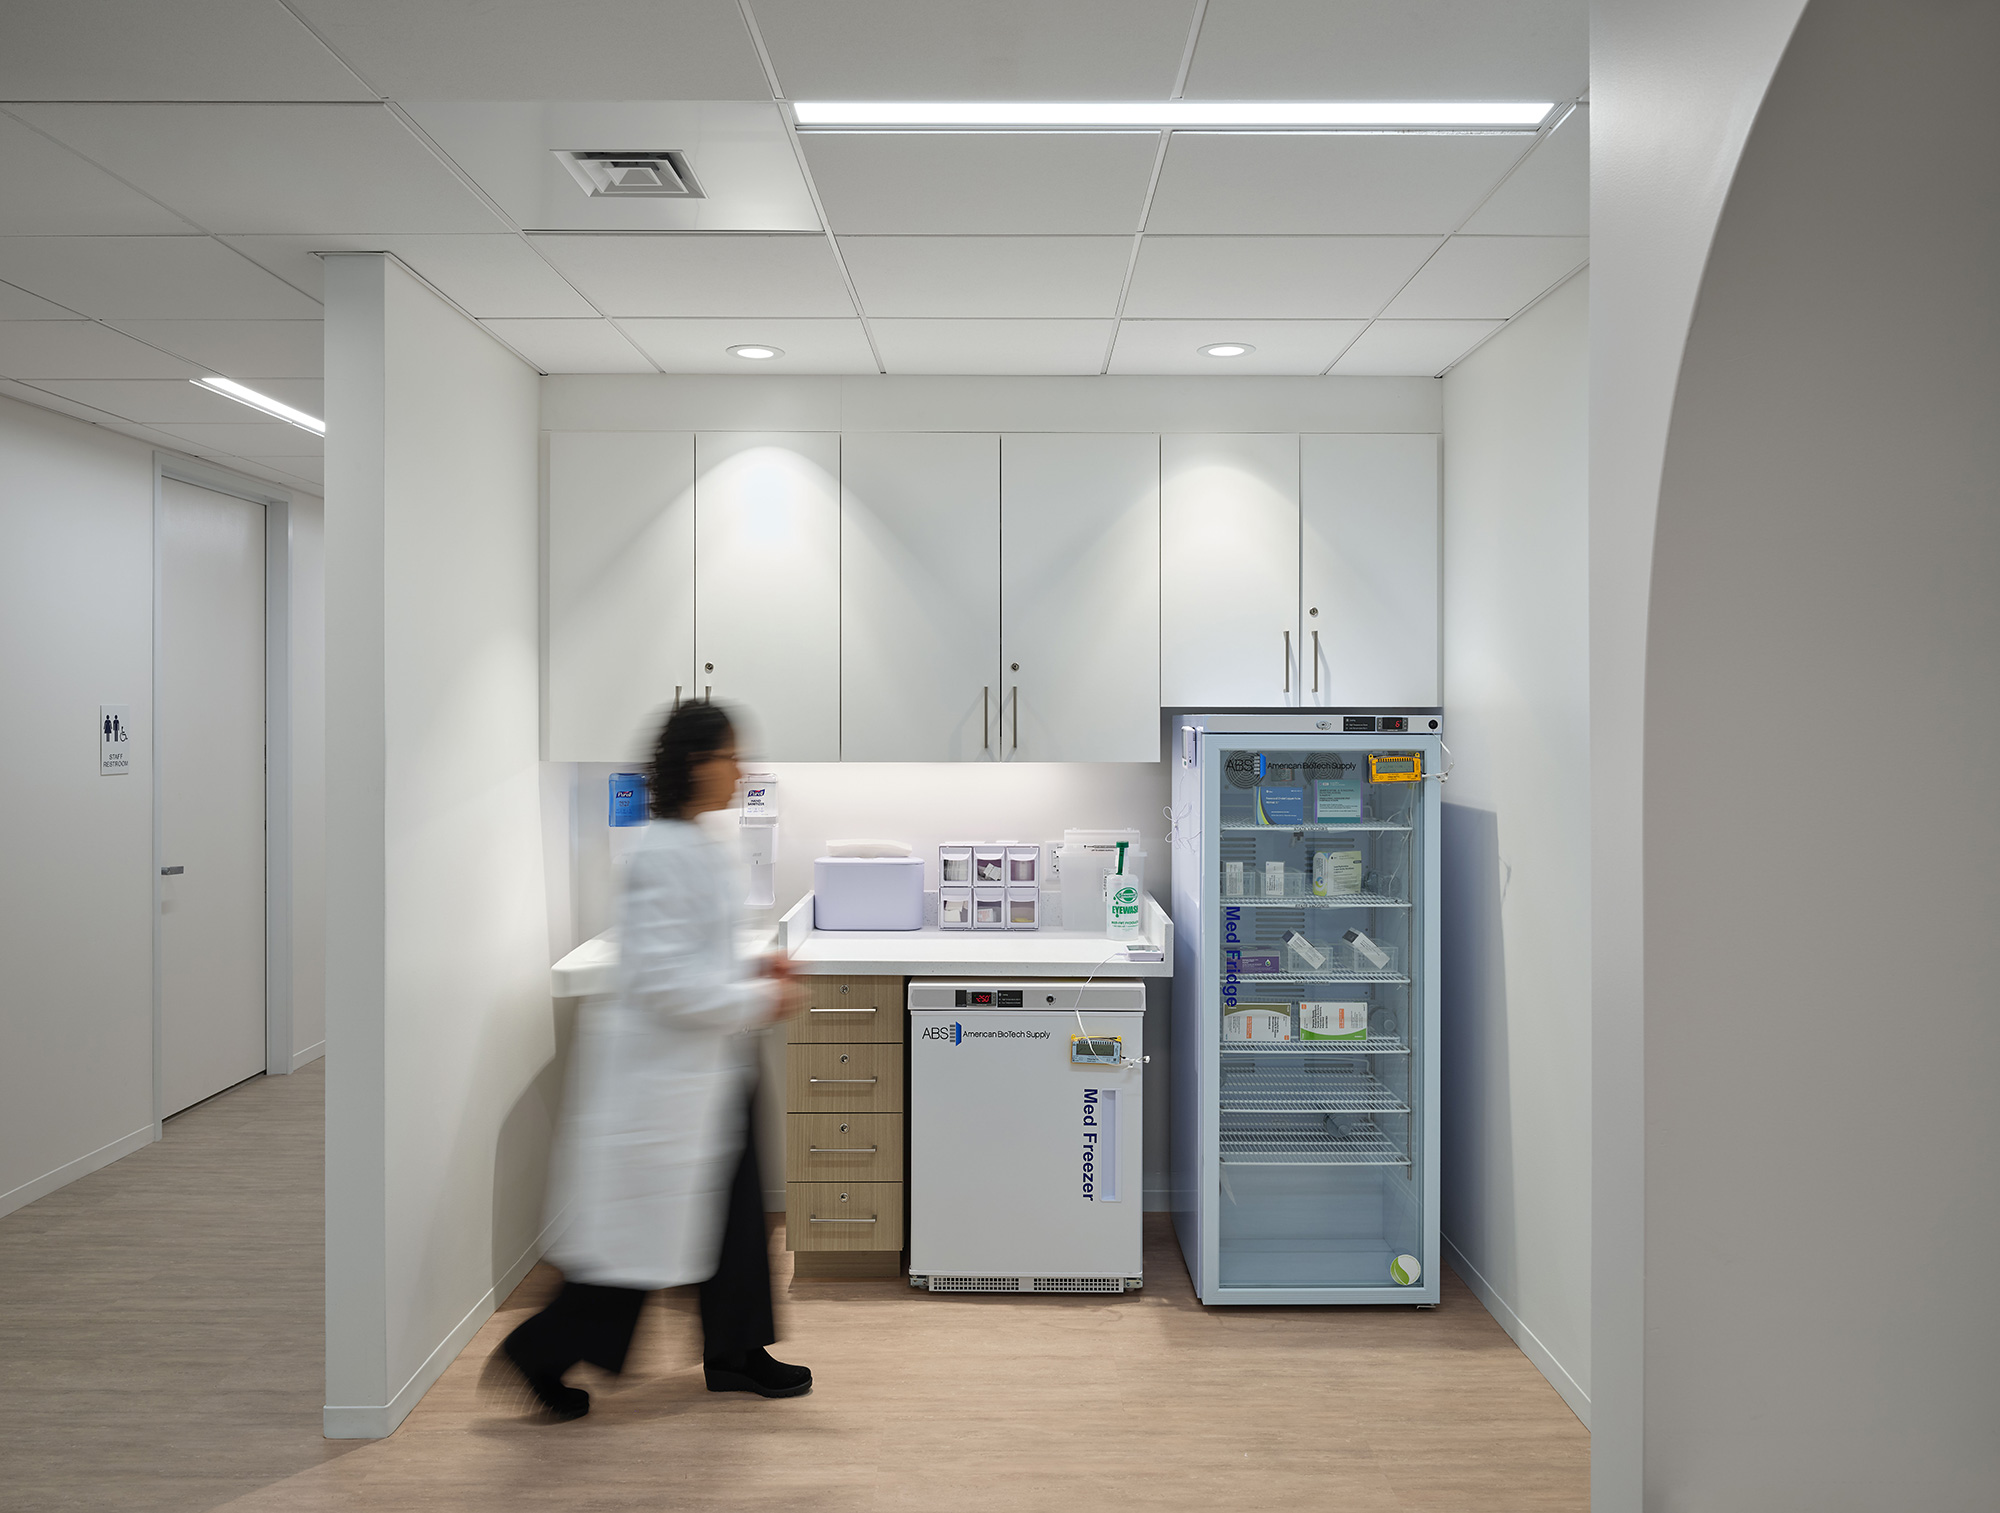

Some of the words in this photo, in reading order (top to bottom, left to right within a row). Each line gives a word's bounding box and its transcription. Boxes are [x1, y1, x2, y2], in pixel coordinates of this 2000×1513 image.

[1226, 759, 1254, 772] ABS
[1267, 762, 1301, 770] American
[1302, 762, 1329, 770] BioTech
[1331, 762, 1356, 771] Supply
[1226, 906, 1241, 943] Med
[1222, 950, 1241, 1007] Fridge
[922, 1027, 949, 1040] ABS
[963, 1030, 997, 1038] American
[998, 1030, 1025, 1038] BioTech
[1026, 1030, 1051, 1040] Supply
[1083, 1089, 1098, 1126] Med
[1083, 1133, 1097, 1201] Freezer
